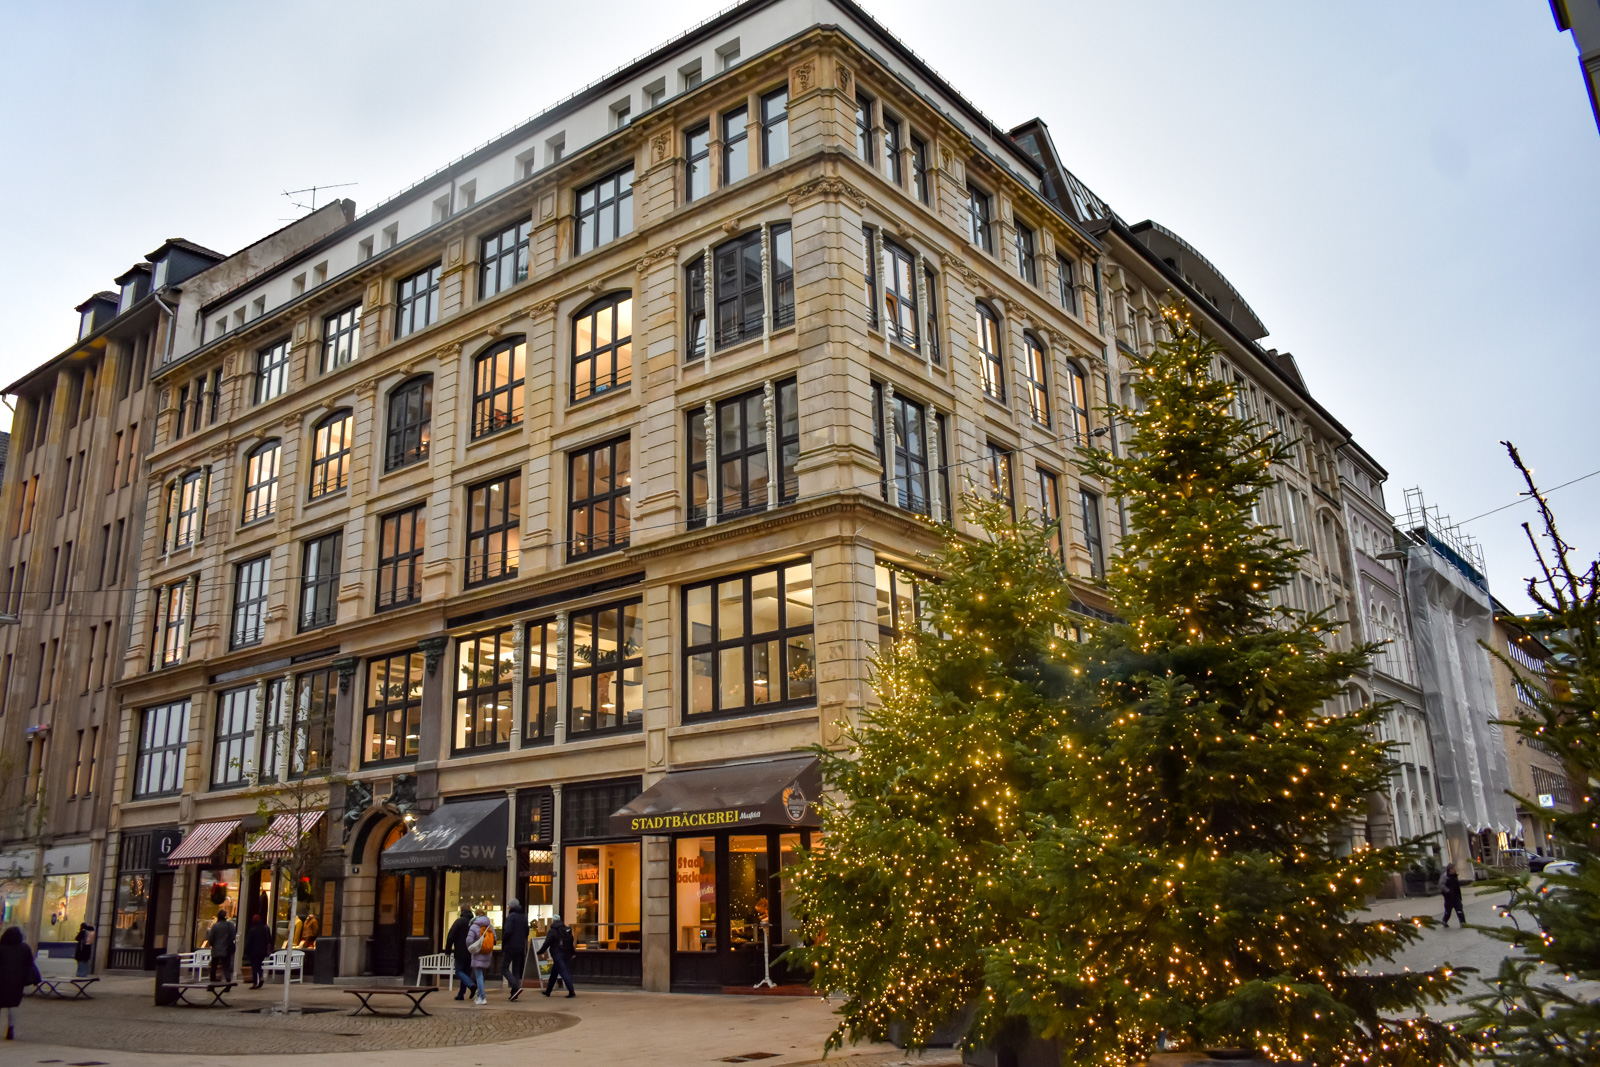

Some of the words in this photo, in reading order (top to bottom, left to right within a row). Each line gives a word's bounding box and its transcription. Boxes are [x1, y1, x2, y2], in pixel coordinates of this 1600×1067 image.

[631, 809, 739, 830] STADTBÄCKEREI
[161, 836, 172, 854] G
[677, 856, 704, 869] Stadt
